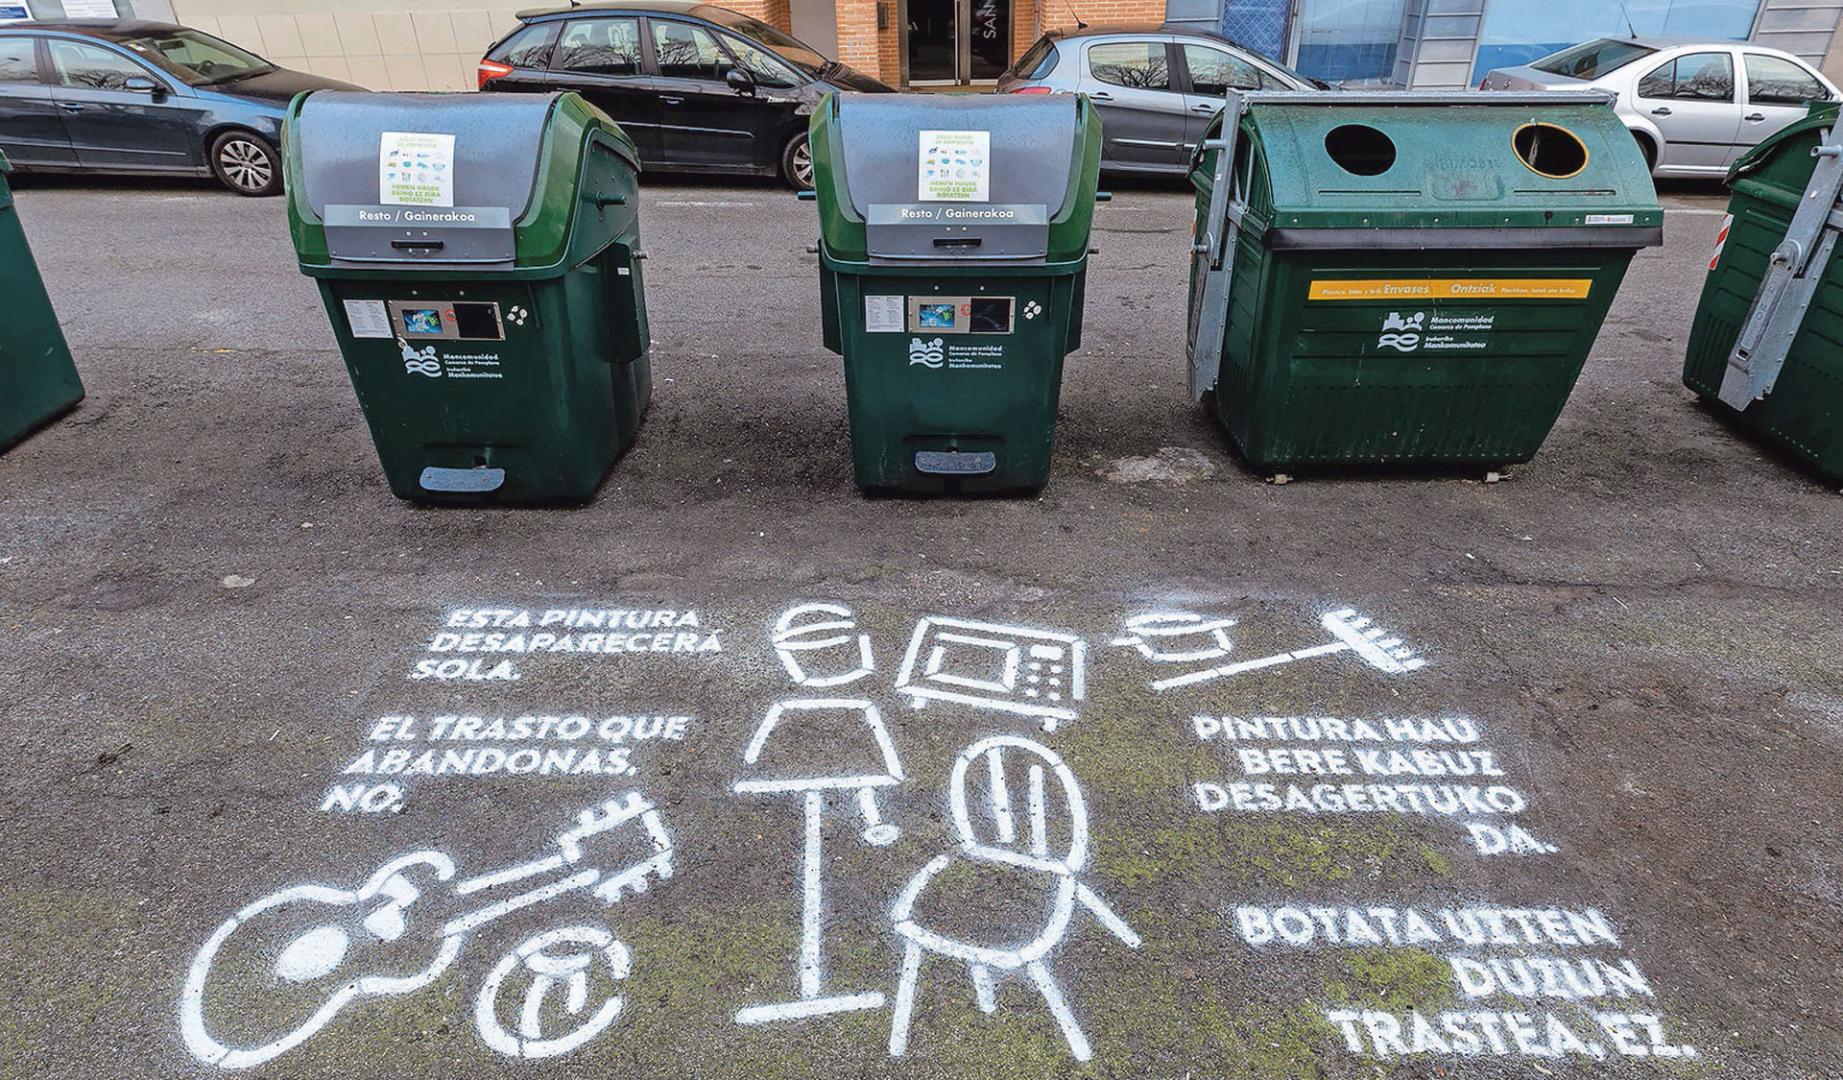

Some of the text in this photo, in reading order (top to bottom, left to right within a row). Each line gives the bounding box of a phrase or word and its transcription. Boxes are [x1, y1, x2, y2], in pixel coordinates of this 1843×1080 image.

[359, 210, 391, 221] Resto
[404, 210, 475, 222] Gainerakoa
[901, 208, 932, 219] Resto
[945, 208, 1014, 219] Gainerakoa
[1383, 284, 1430, 294] Envases
[1451, 283, 1496, 294] Ontziak
[447, 609, 700, 628] ESTA PINTURA
[429, 629, 723, 653] DESAPARECERÁ
[408, 659, 521, 681] SOLA.
[369, 715, 690, 744] EL TRASTO QUE
[1192, 715, 1481, 743] PINTURA HAU
[1238, 749, 1506, 777] BERE KABUZ
[320, 784, 404, 813] NO.
[1193, 782, 1528, 814] DESAGERTUKO
[1463, 822, 1560, 855] DA.
[1235, 906, 1622, 948] BOTATA UZTEN
[1450, 957, 1657, 999] DUZUN
[1596, 1011, 1698, 1058] EZ.
